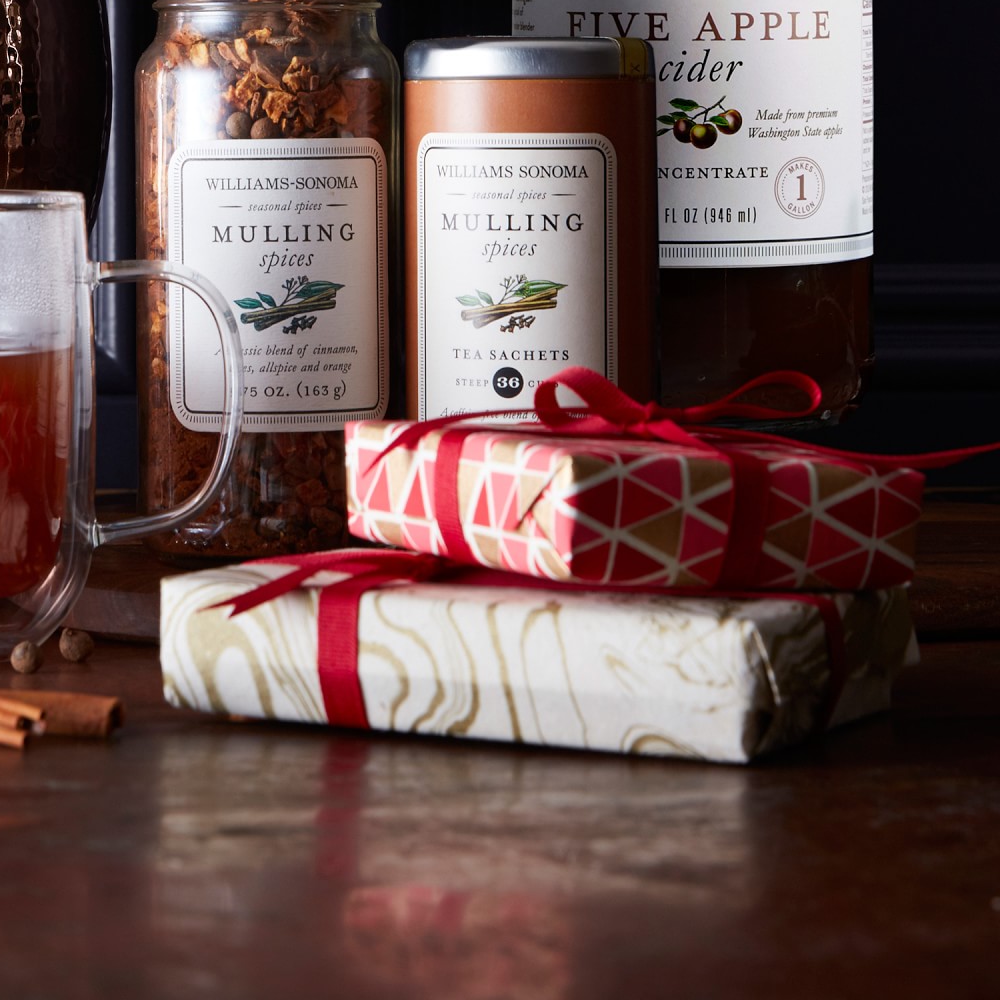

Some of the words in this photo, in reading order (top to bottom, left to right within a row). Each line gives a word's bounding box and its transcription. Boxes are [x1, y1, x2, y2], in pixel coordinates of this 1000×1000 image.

[567, 11, 670, 41] FIVE
[692, 10, 831, 41] APPLE
[658, 48, 743, 82] cider
[755, 109, 783, 121] Made
[783, 109, 805, 123] from
[806, 107, 838, 122] premium
[748, 126, 801, 141] Washington
[802, 125, 822, 137] State
[823, 124, 843, 139] apples
[437, 165, 513, 178] WILLIAMS
[519, 165, 589, 178] SONOMA
[657, 167, 769, 179] NCENTRATE
[788, 162, 814, 175] MAKES
[206, 175, 359, 191] WILLIAMS-SONOMA
[796, 174, 807, 201] 1
[472, 189, 515, 200] seasonal
[517, 189, 547, 203] spices
[248, 201, 292, 212] seasonal
[294, 201, 323, 214] spices
[664, 207, 677, 223] FL
[684, 207, 698, 223] OZ
[704, 207, 732, 224] (946
[738, 207, 757, 224] ml)
[787, 201, 816, 214] GALLON
[441, 213, 585, 232] MULLING
[212, 223, 356, 243] MULLING
[481, 237, 538, 263] spices
[259, 248, 315, 274] spices
[266, 344, 294, 356] blend
[296, 344, 309, 359] of
[313, 344, 358, 355] cinnamon,
[453, 349, 483, 360] TEA
[489, 350, 570, 361] SACHETS
[259, 362, 297, 376] allspice
[300, 361, 321, 373] and
[322, 363, 352, 373] orange
[264, 386, 290, 397] OZ.
[296, 380, 329, 398] (163
[333, 379, 346, 400] g)
[455, 378, 489, 387] STEEP
[496, 376, 520, 389] 36
